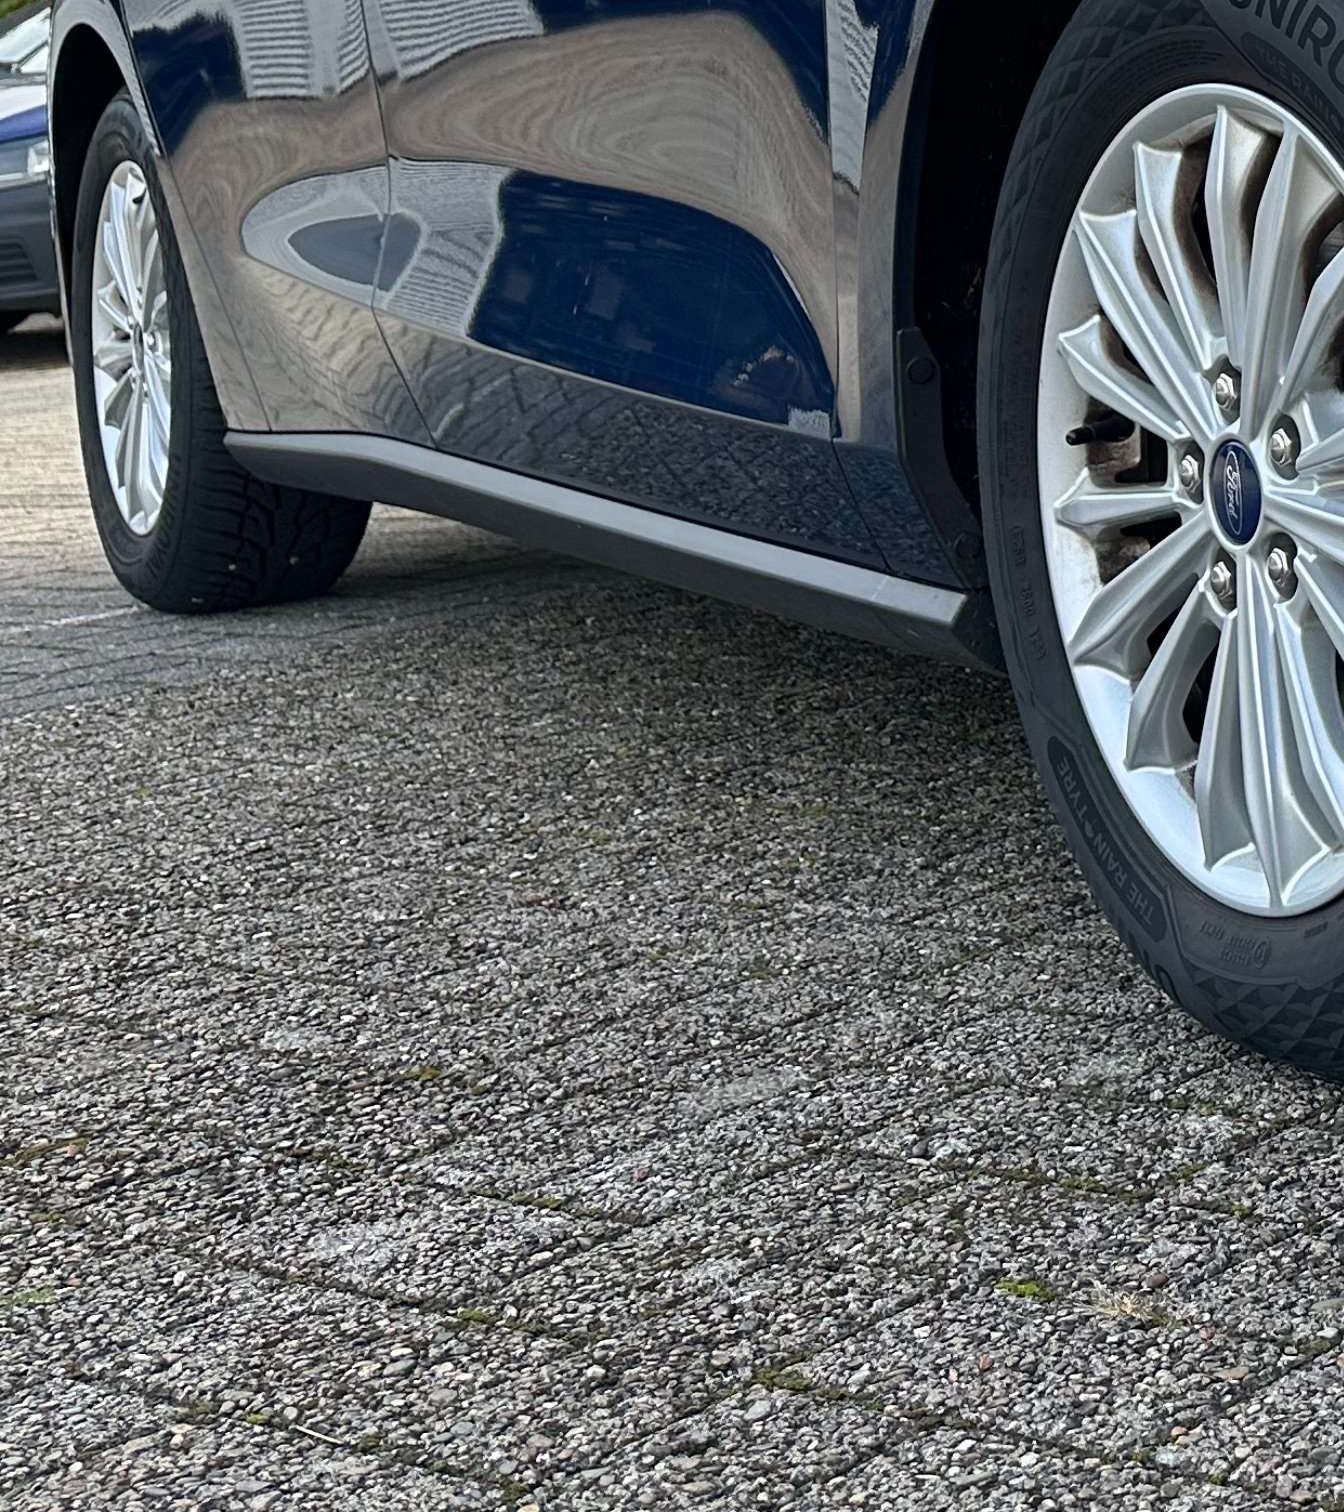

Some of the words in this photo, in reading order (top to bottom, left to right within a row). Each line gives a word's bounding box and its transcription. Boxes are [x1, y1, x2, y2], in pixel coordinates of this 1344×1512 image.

[1225, 464, 1241, 521] Ford
[1056, 752, 1094, 822] TYRE
[1093, 835, 1130, 886] RAIN
[1126, 886, 1156, 927] THE
